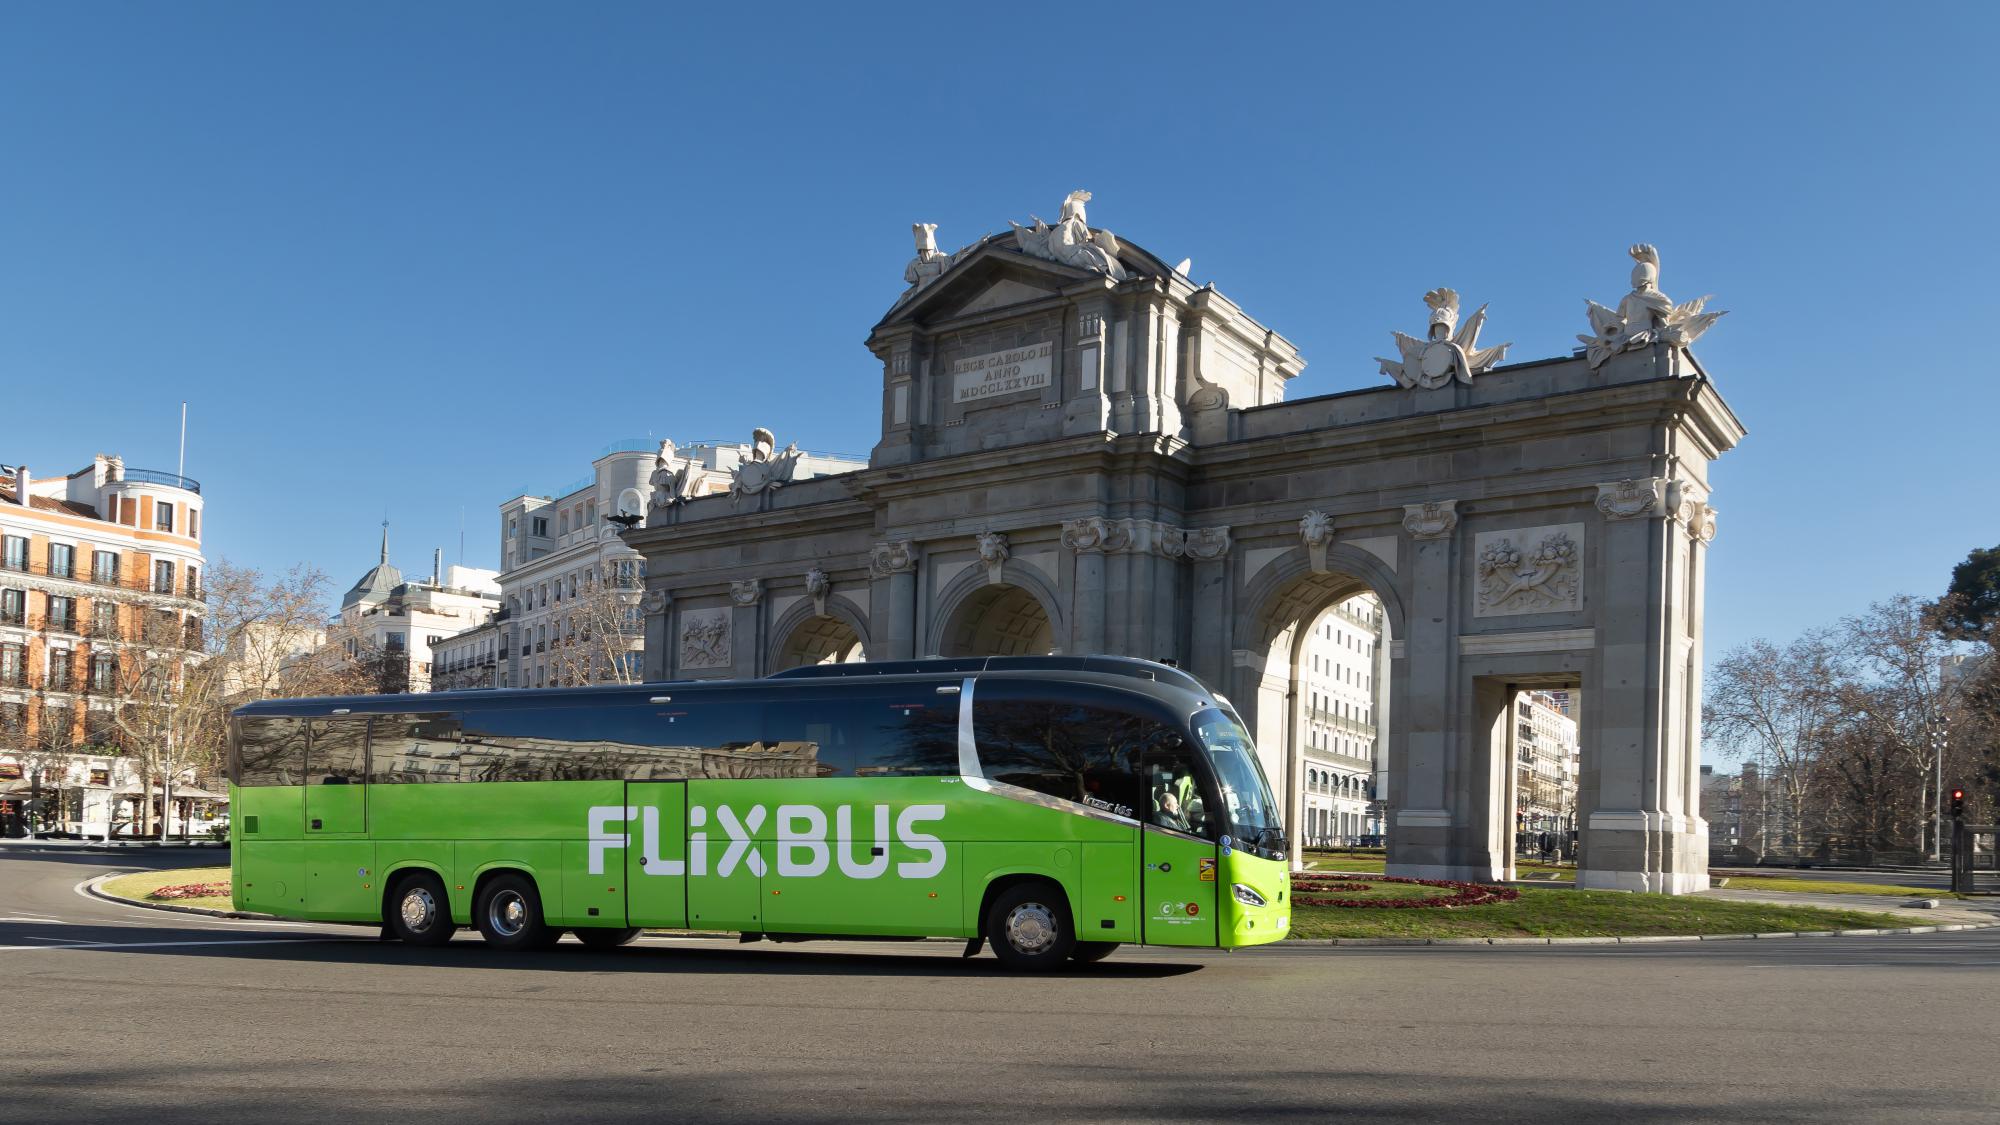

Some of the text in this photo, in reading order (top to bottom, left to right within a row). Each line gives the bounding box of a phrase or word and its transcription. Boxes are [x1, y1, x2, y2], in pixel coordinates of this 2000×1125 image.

[988, 349, 1036, 368] CAROLO
[984, 365, 1021, 381] ANNO
[960, 373, 1045, 399] MDCCLXXVIII
